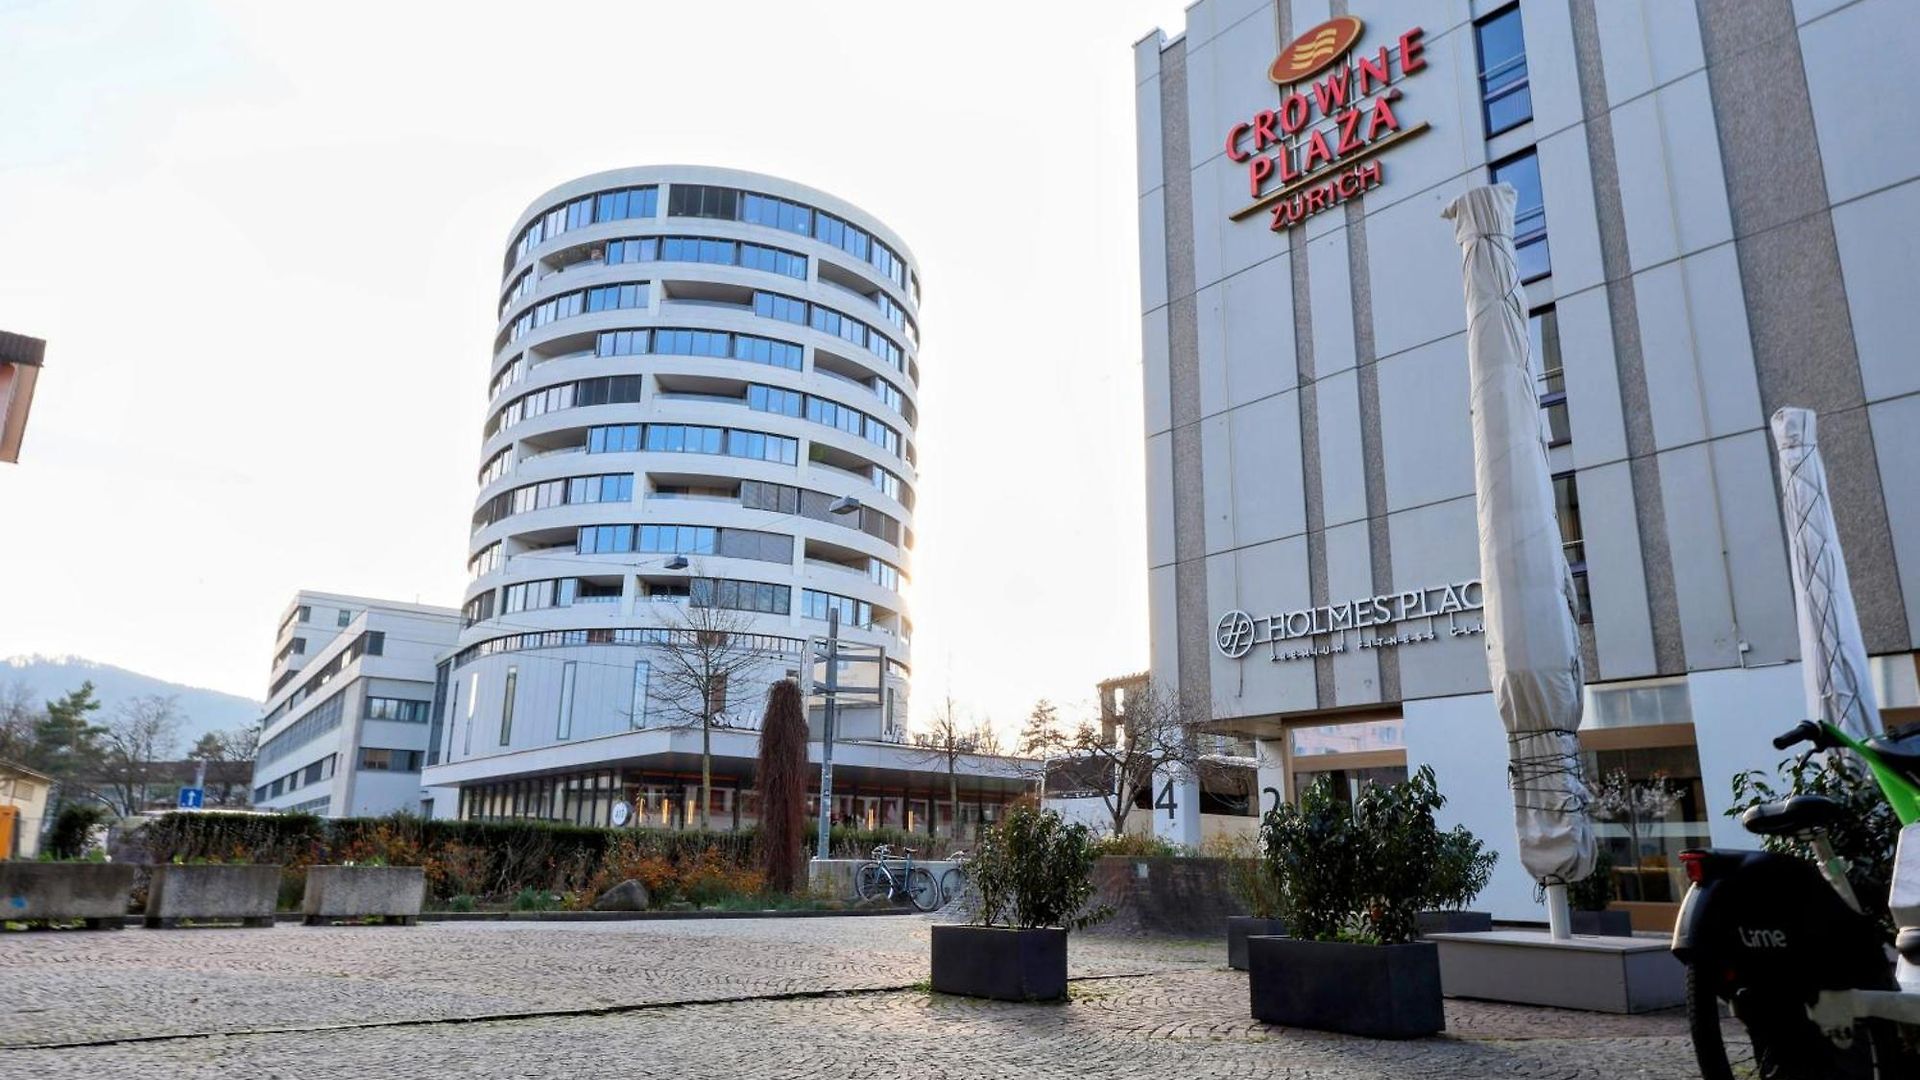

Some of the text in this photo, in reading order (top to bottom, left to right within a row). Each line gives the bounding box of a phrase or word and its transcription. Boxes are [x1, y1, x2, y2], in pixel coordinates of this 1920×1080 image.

[1225, 26, 1428, 163] CROWNE
[1250, 96, 1401, 199] PLAZA
[1268, 579, 1484, 640] HOLMES PLAC
[1450, 622, 1486, 637] CLU
[1155, 778, 1178, 819] 4
[1738, 926, 1787, 948] Lime
